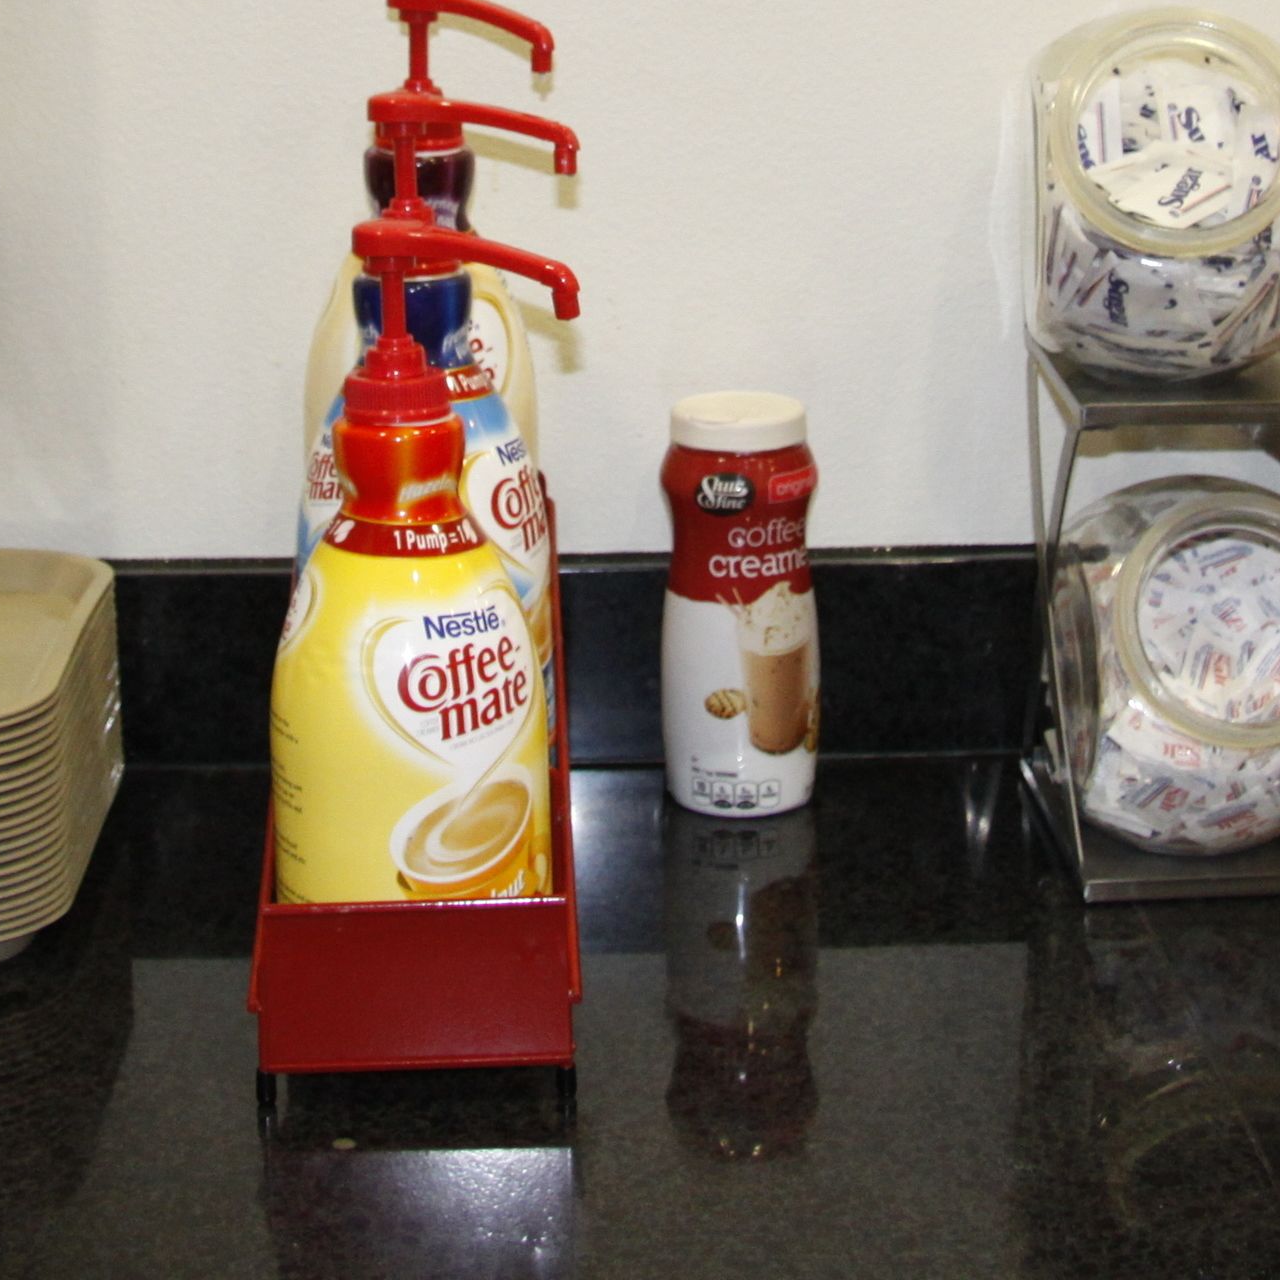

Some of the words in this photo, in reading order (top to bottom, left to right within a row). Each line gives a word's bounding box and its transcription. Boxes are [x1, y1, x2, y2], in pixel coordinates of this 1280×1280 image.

[406, 529, 448, 554] Pump
[422, 604, 500, 640] Nestlé
[439, 670, 528, 741] mate
